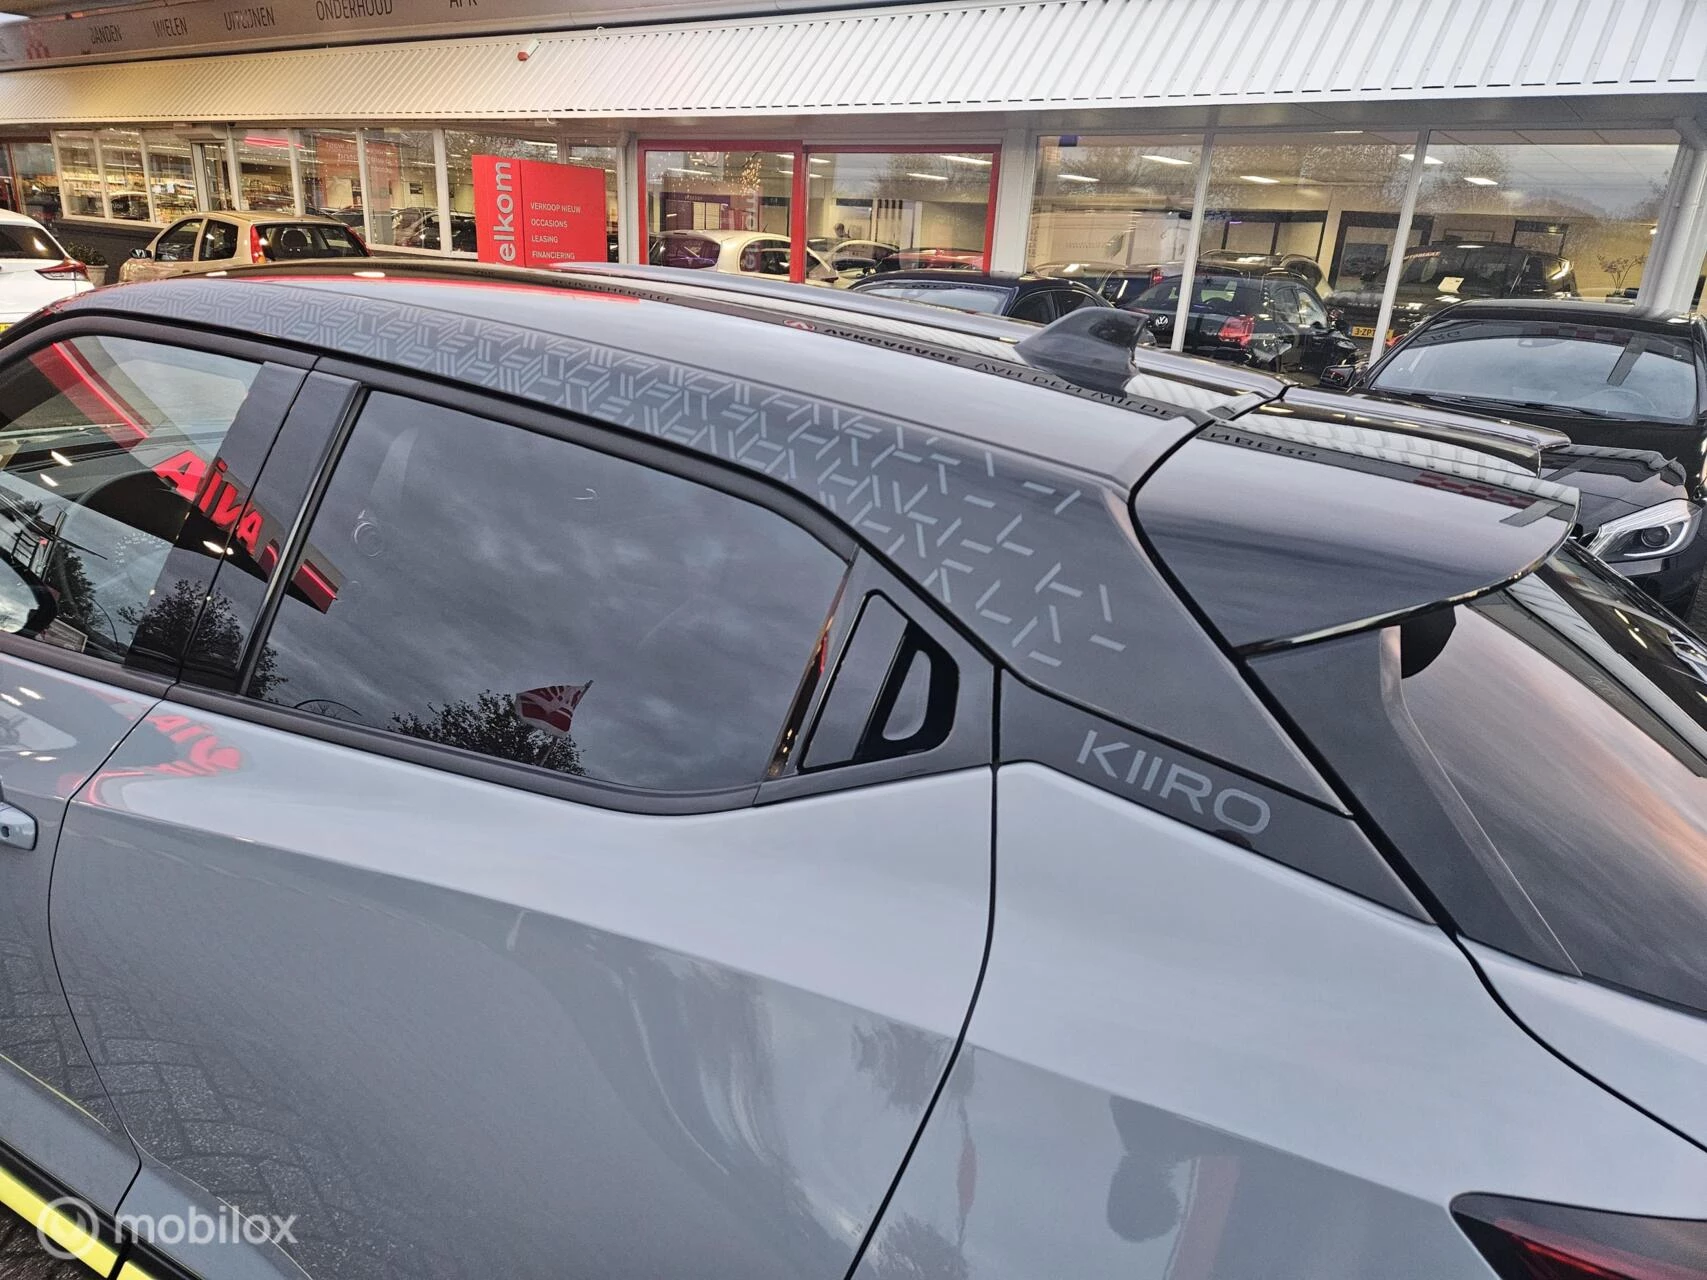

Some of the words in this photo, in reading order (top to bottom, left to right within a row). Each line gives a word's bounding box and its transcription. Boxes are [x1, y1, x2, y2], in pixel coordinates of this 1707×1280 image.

[493, 161, 516, 262] elkom
[530, 202, 561, 212] VERKOOP
[562, 205, 581, 214] NIEUW
[530, 218, 568, 228] OCCASIONS
[531, 235, 559, 244] LEASING
[532, 250, 576, 260] FINANCIERING
[1076, 729, 1271, 835] KIIRO
